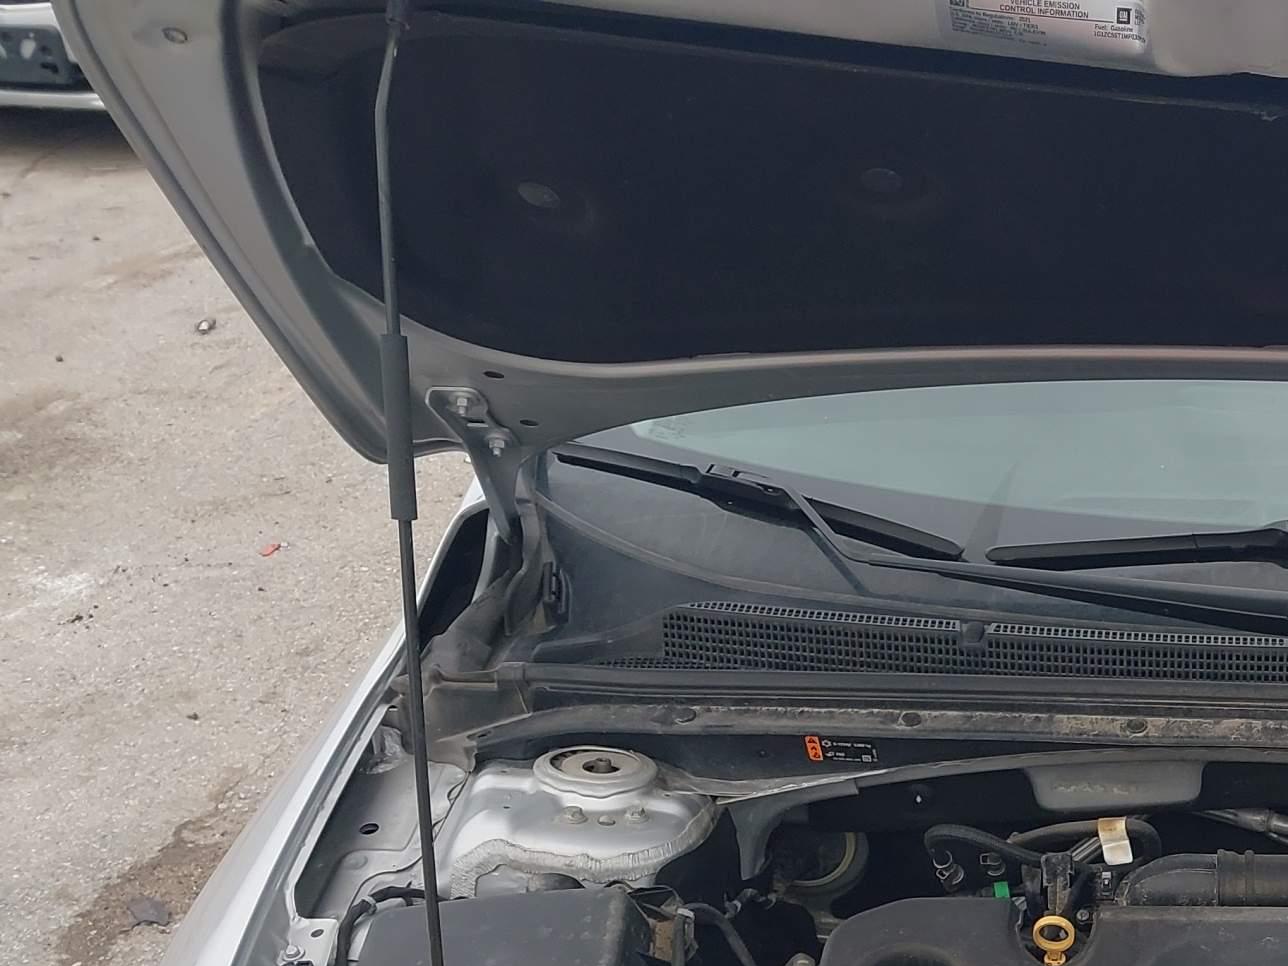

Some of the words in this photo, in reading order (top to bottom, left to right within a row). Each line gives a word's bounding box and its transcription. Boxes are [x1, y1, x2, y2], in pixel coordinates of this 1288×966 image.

[1043, 0, 1081, 10] EMISSION
[999, 4, 1035, 14] CONTROL
[1037, 7, 1089, 18] INFORMATION
[1110, 25, 1134, 33] Gasoline
